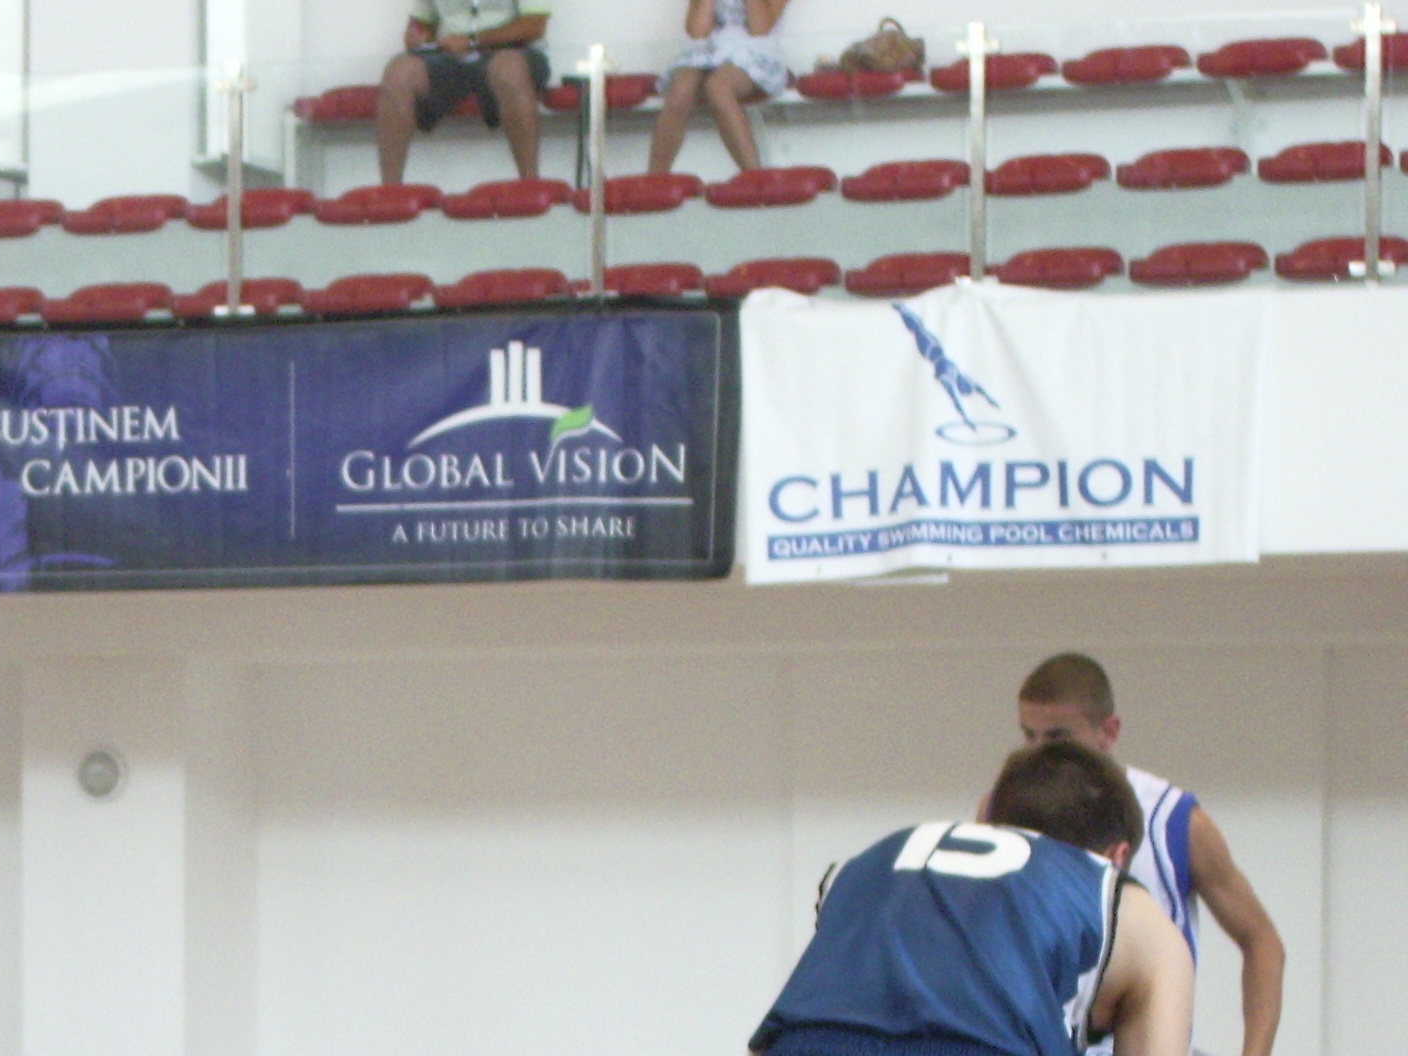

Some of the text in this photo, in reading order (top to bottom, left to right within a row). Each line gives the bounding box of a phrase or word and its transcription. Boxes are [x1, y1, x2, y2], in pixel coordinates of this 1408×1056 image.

[21, 454, 249, 497] CAMPIONII
[342, 442, 686, 492] GLOBAL VISION
[768, 457, 1194, 523] CHAMPION
[392, 514, 638, 543] A FUTURE TO SHARE
[773, 519, 1195, 558] QUALITY SWIMMING POOL CHEMICALS
